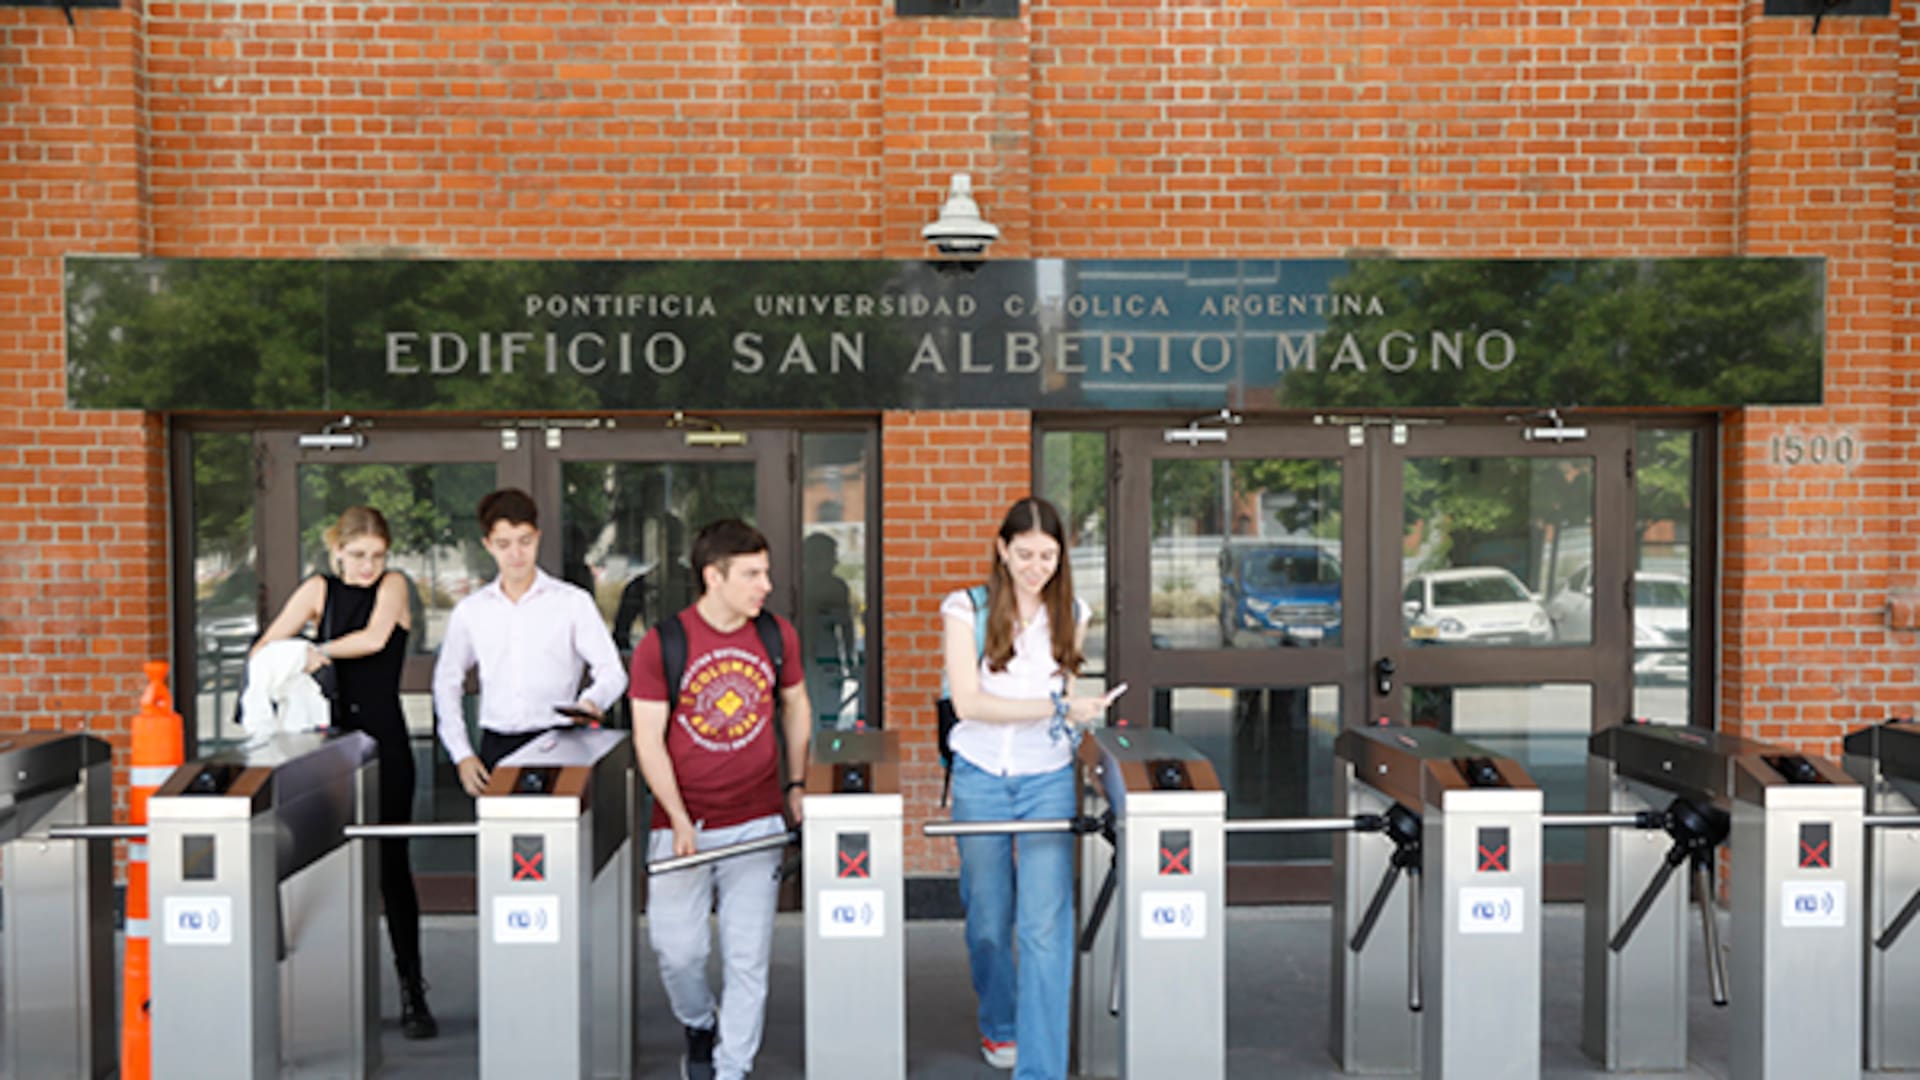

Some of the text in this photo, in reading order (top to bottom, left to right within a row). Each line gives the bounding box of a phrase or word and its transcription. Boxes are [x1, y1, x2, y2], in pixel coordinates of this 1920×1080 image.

[525, 295, 717, 317] PONTIFICIA
[754, 295, 977, 317] UNIVERSIDAD
[1201, 294, 1384, 317] ARGENTINA
[385, 329, 1517, 375] EDIFICIO SAN ALBERTO MAGNO
[1772, 435, 1853, 464] 1500
[690, 661, 766, 692] COLUMBIA
